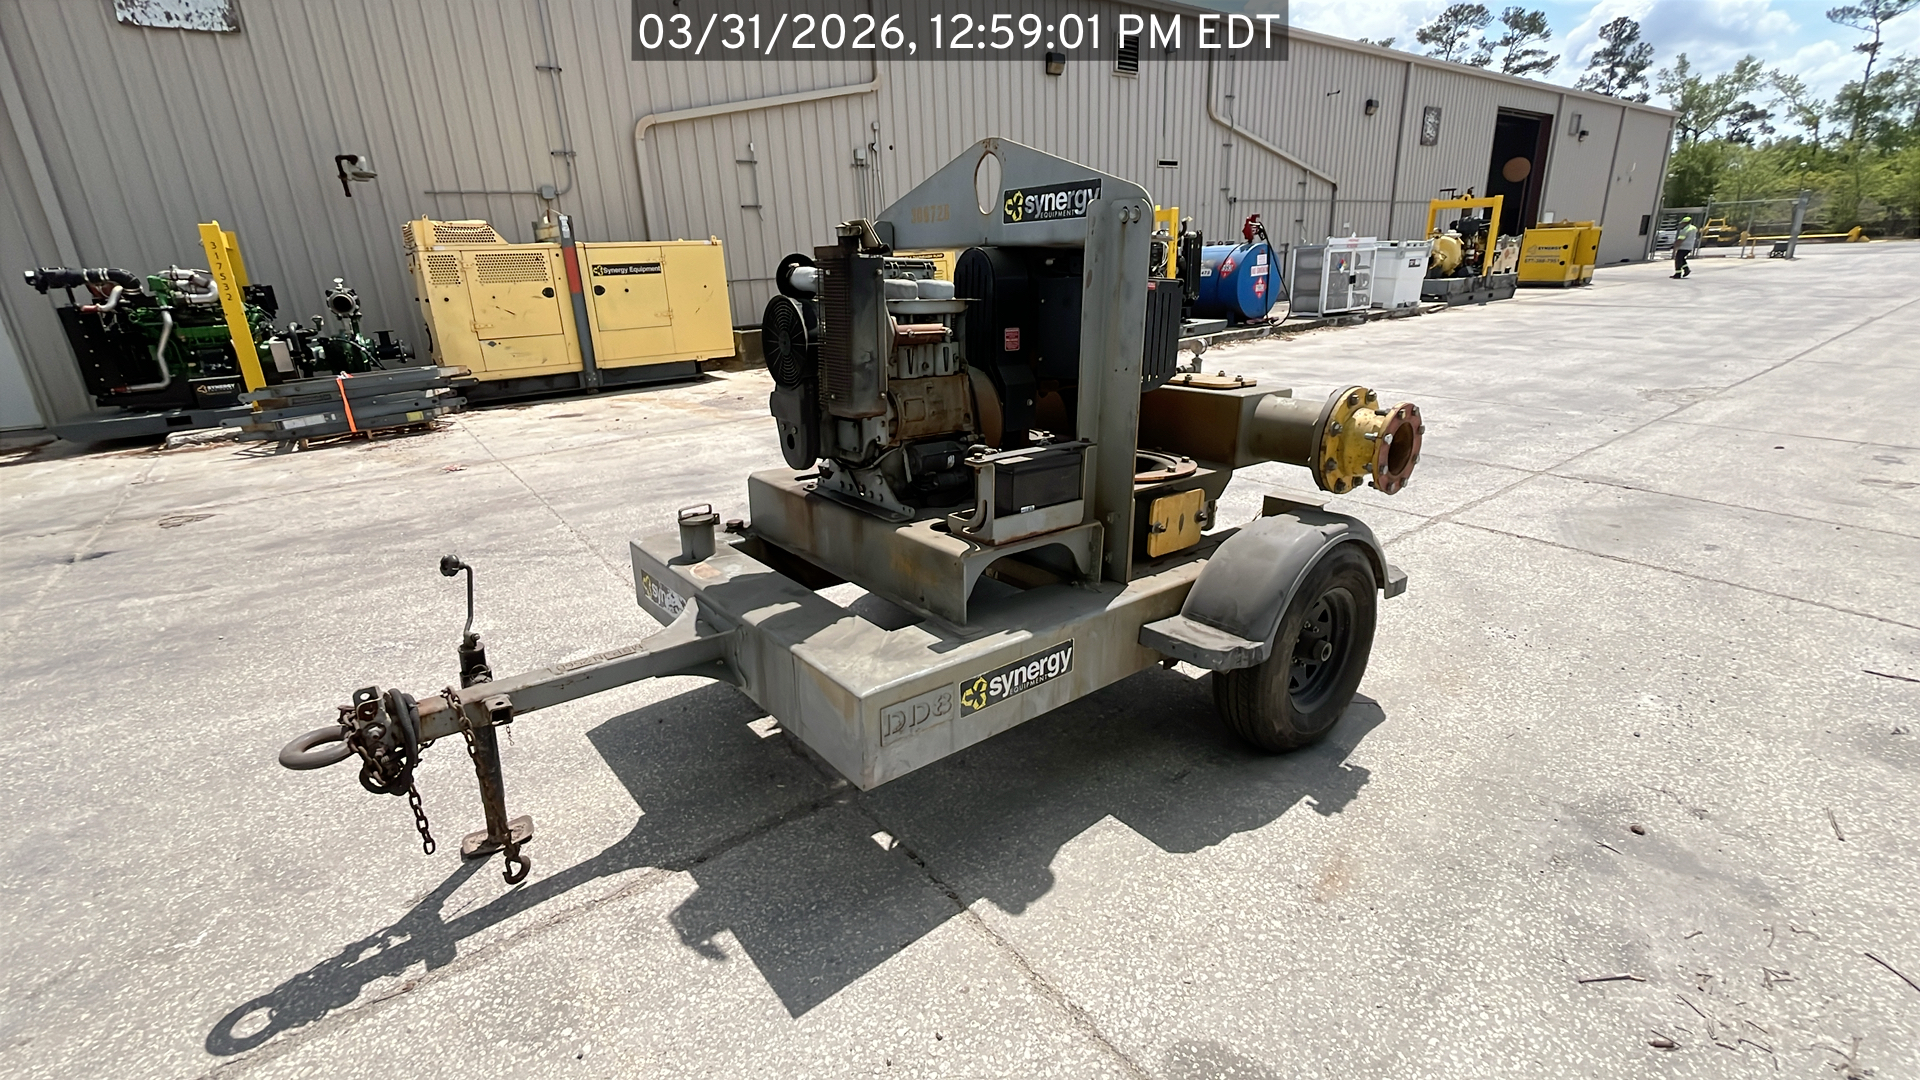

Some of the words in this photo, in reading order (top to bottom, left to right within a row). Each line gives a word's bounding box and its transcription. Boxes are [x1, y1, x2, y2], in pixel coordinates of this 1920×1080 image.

[1025, 187, 1100, 218] synergy
[1040, 208, 1075, 218] EQUIPMENT
[210, 241, 233, 301] 317532
[989, 647, 1072, 698] synergy
[1010, 674, 1048, 695] EQUIPMENT
[884, 692, 952, 738] DD8
